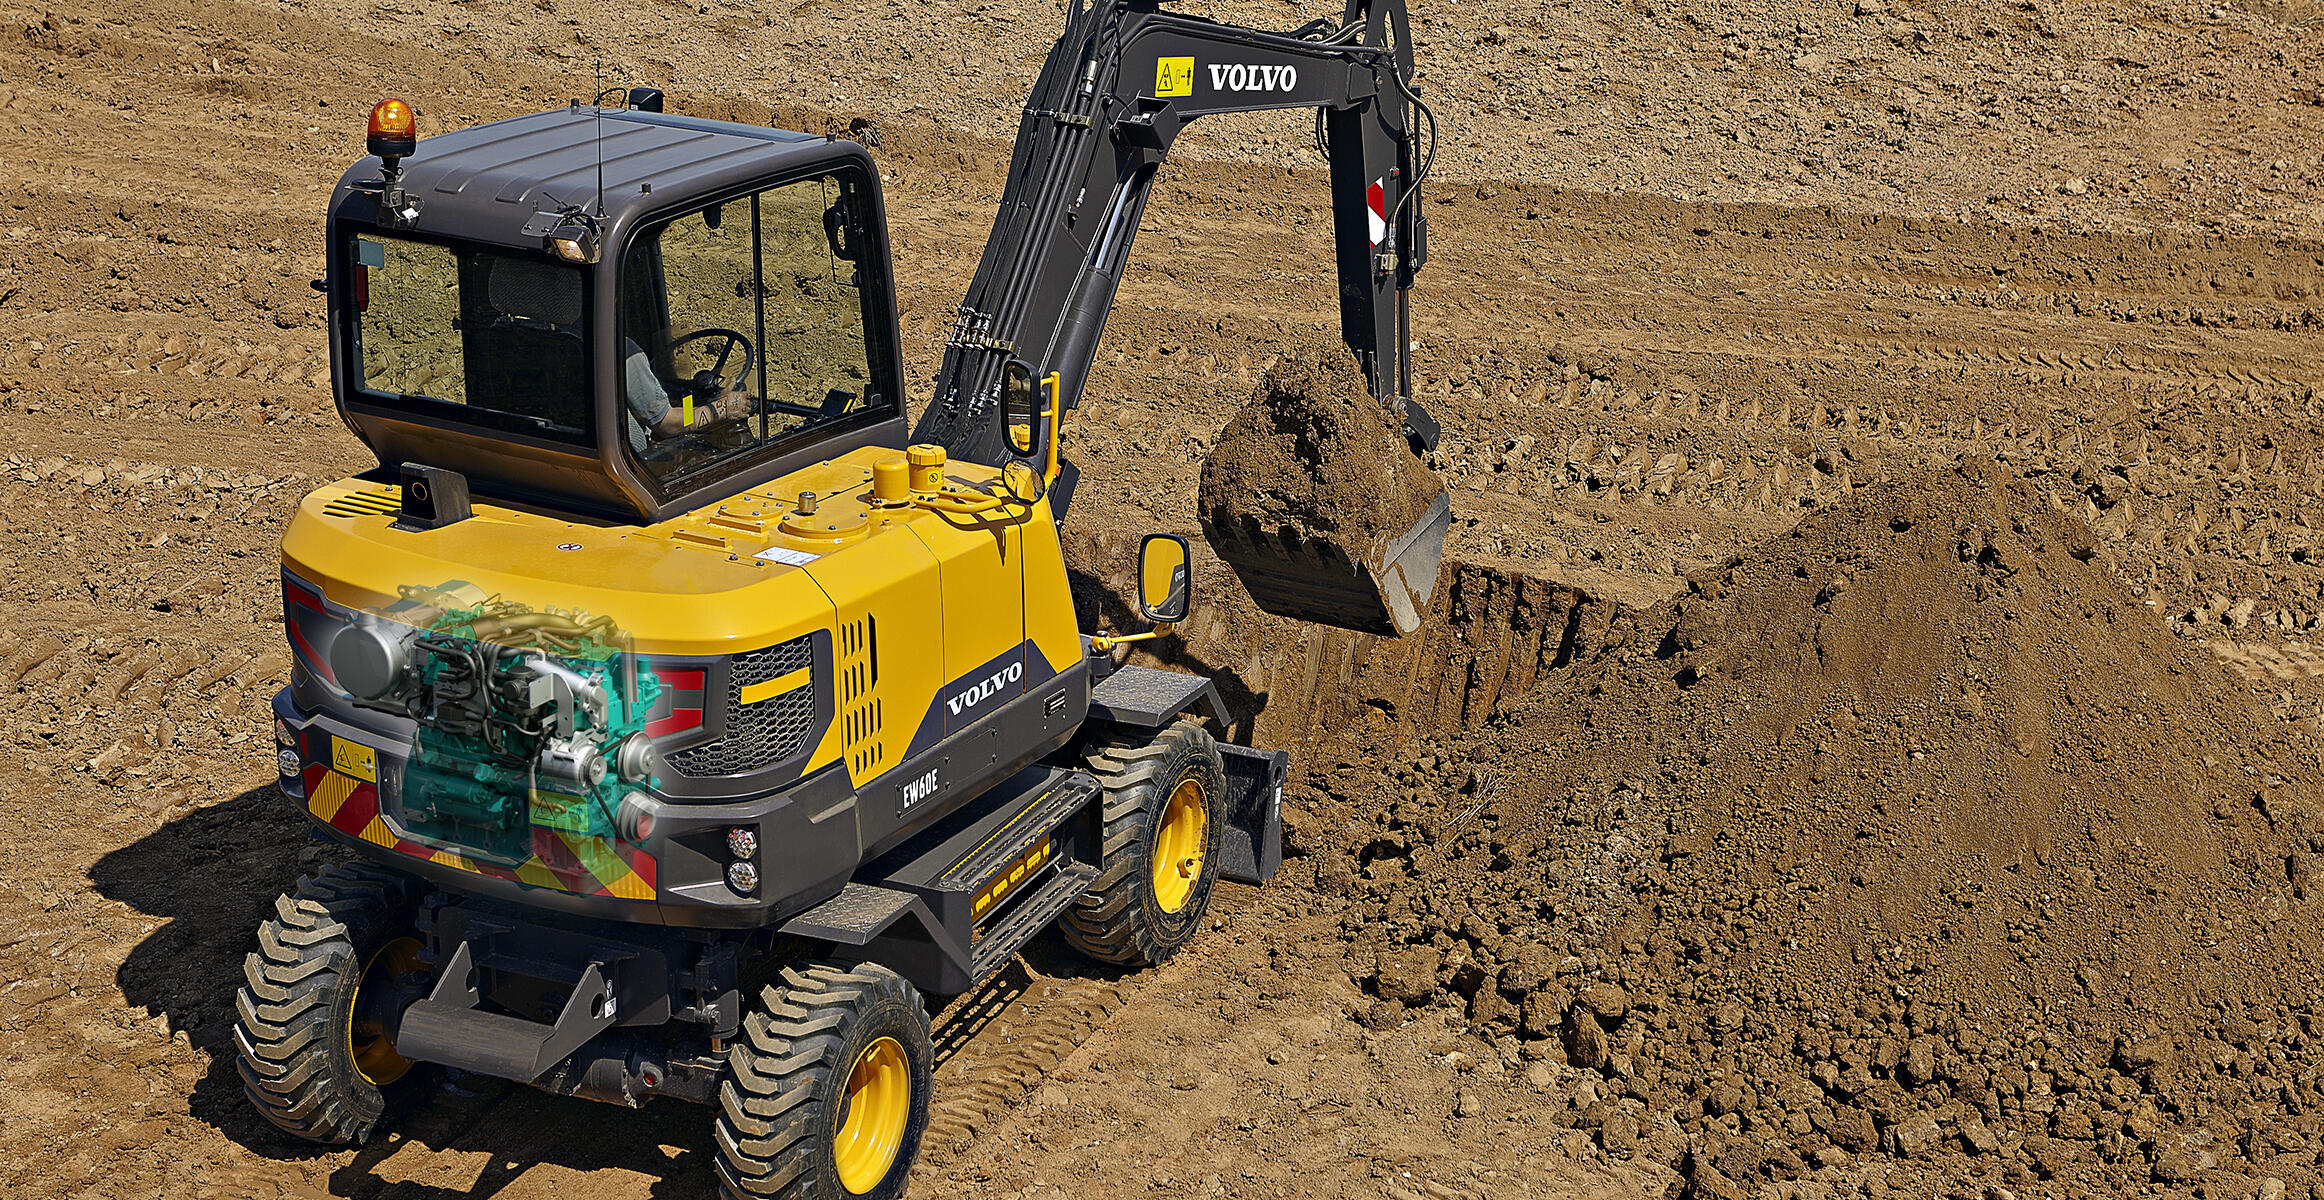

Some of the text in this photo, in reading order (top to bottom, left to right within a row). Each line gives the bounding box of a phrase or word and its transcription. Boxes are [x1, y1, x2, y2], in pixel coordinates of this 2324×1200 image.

[1207, 63, 1297, 92] VOLVO
[946, 660, 1023, 716] VOLVO
[903, 768, 938, 809] EW60E
